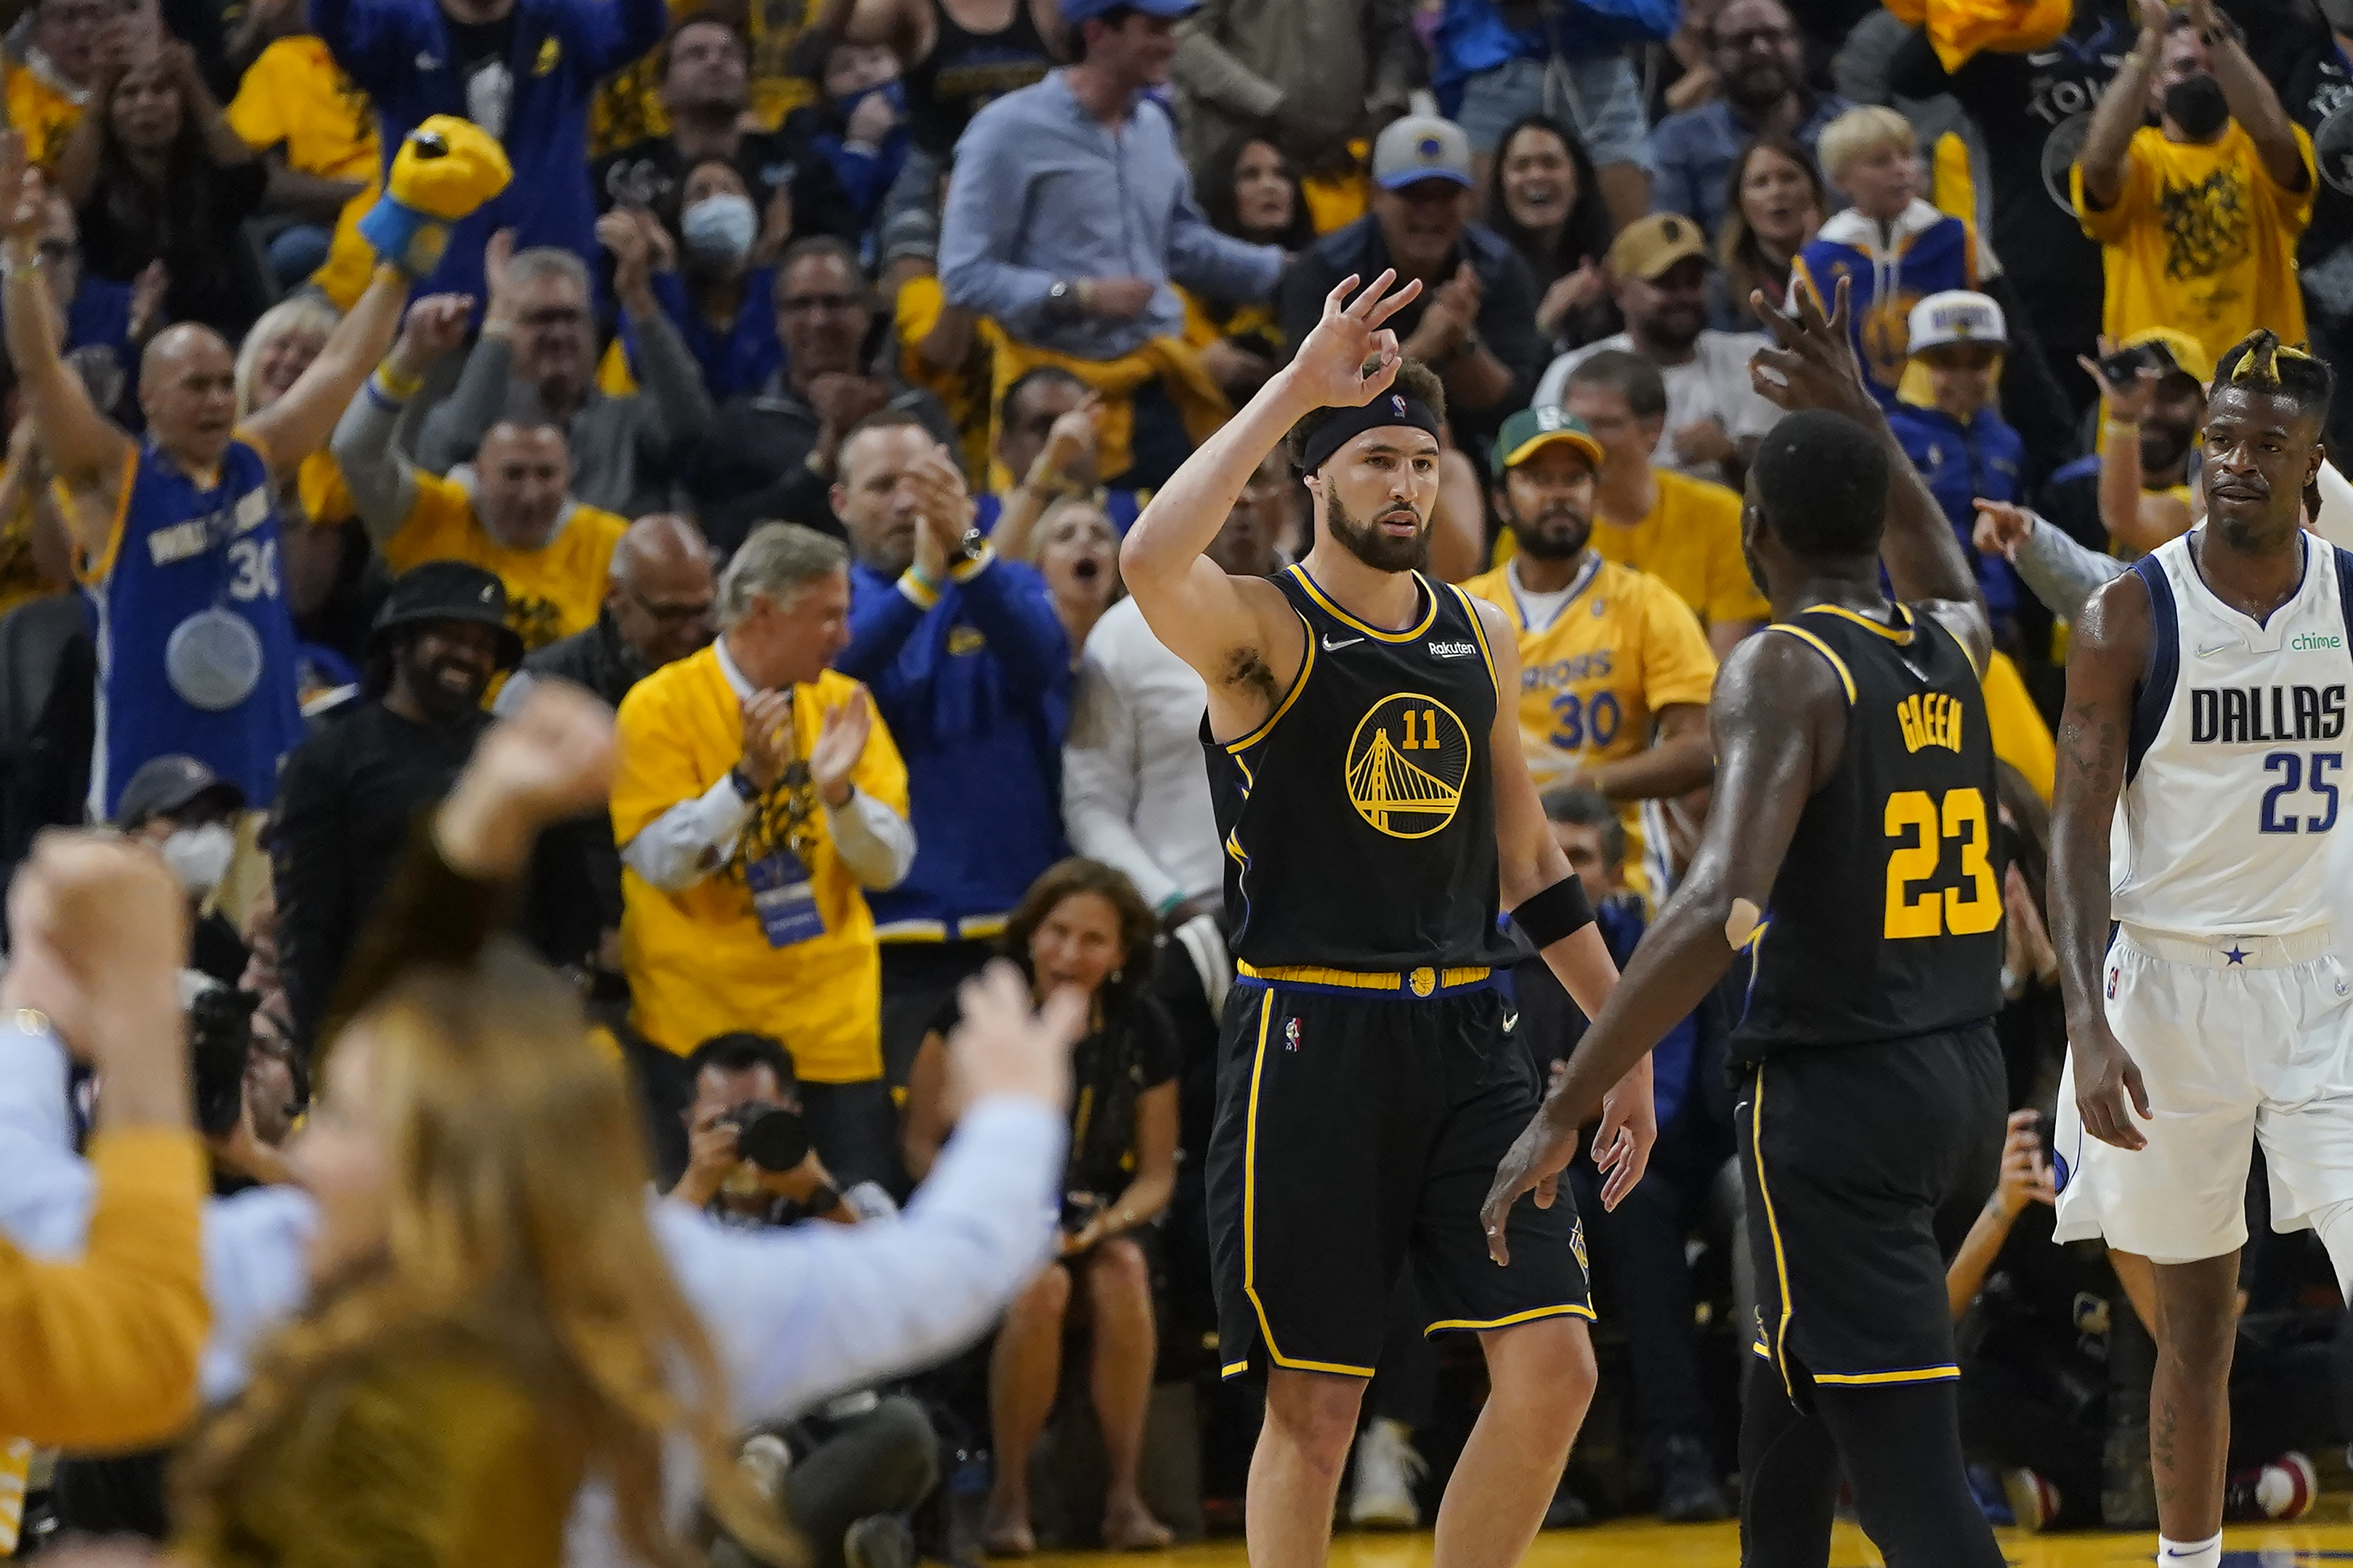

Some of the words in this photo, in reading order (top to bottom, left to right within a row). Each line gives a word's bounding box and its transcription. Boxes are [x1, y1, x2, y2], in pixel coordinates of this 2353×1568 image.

[1428, 641, 1476, 655] Rakuten
[2291, 632, 2341, 651] chime
[1402, 709, 1441, 750] 11
[1550, 691, 1619, 750] 30
[1897, 692, 1963, 754] GREEN
[2190, 684, 2346, 744] DALLAS
[2259, 751, 2344, 834] 25
[1884, 787, 2003, 939] 23
